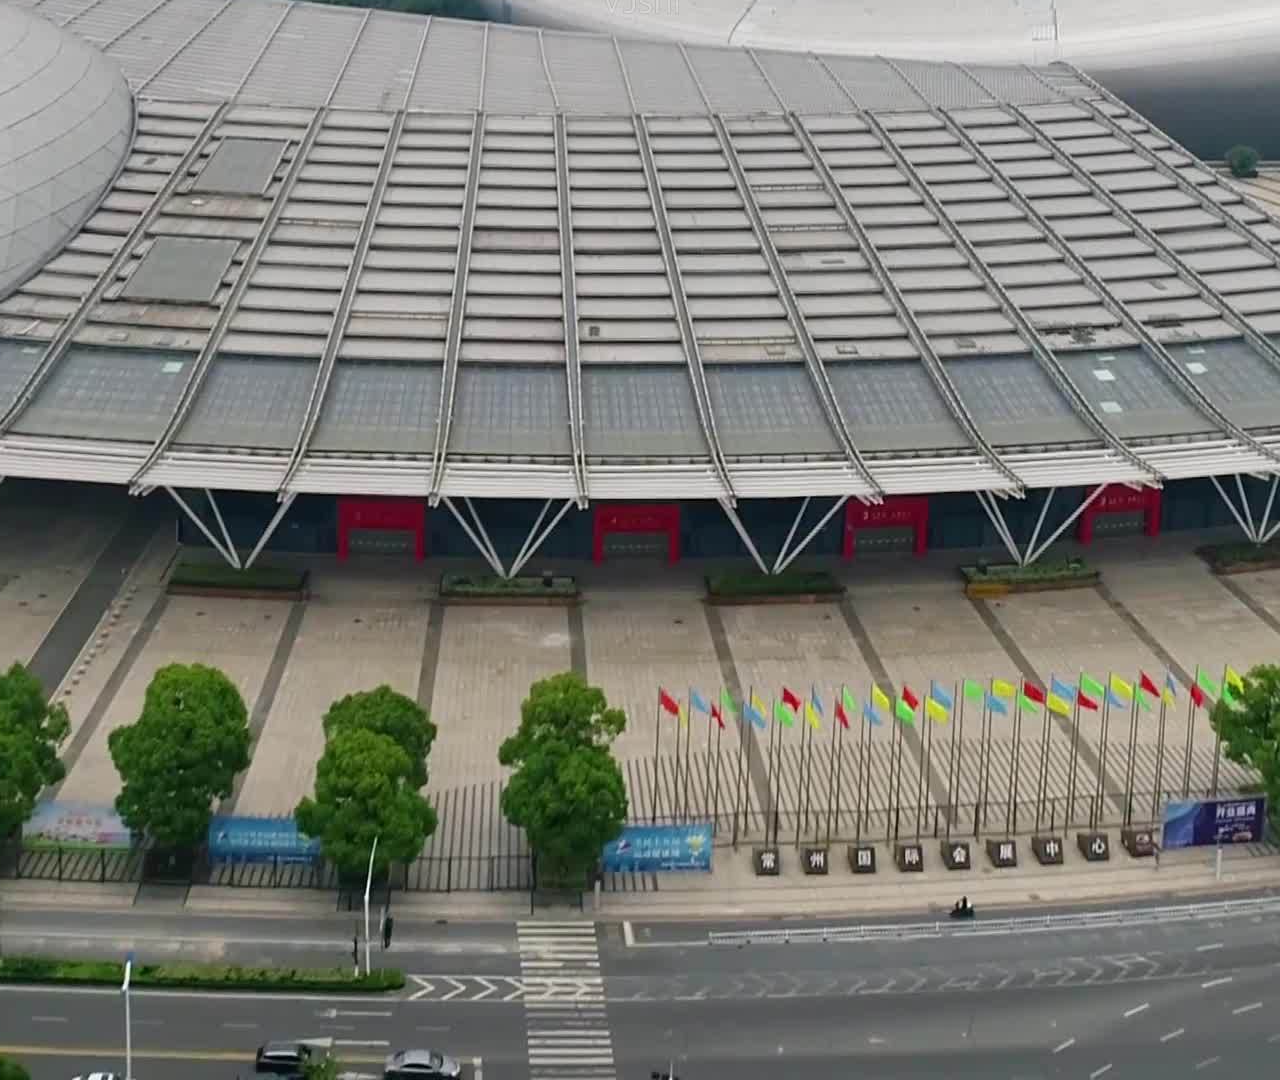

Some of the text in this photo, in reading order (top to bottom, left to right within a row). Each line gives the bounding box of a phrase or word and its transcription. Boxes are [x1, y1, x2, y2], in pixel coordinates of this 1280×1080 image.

[760, 837, 1106, 869] 常州国际会展中心
